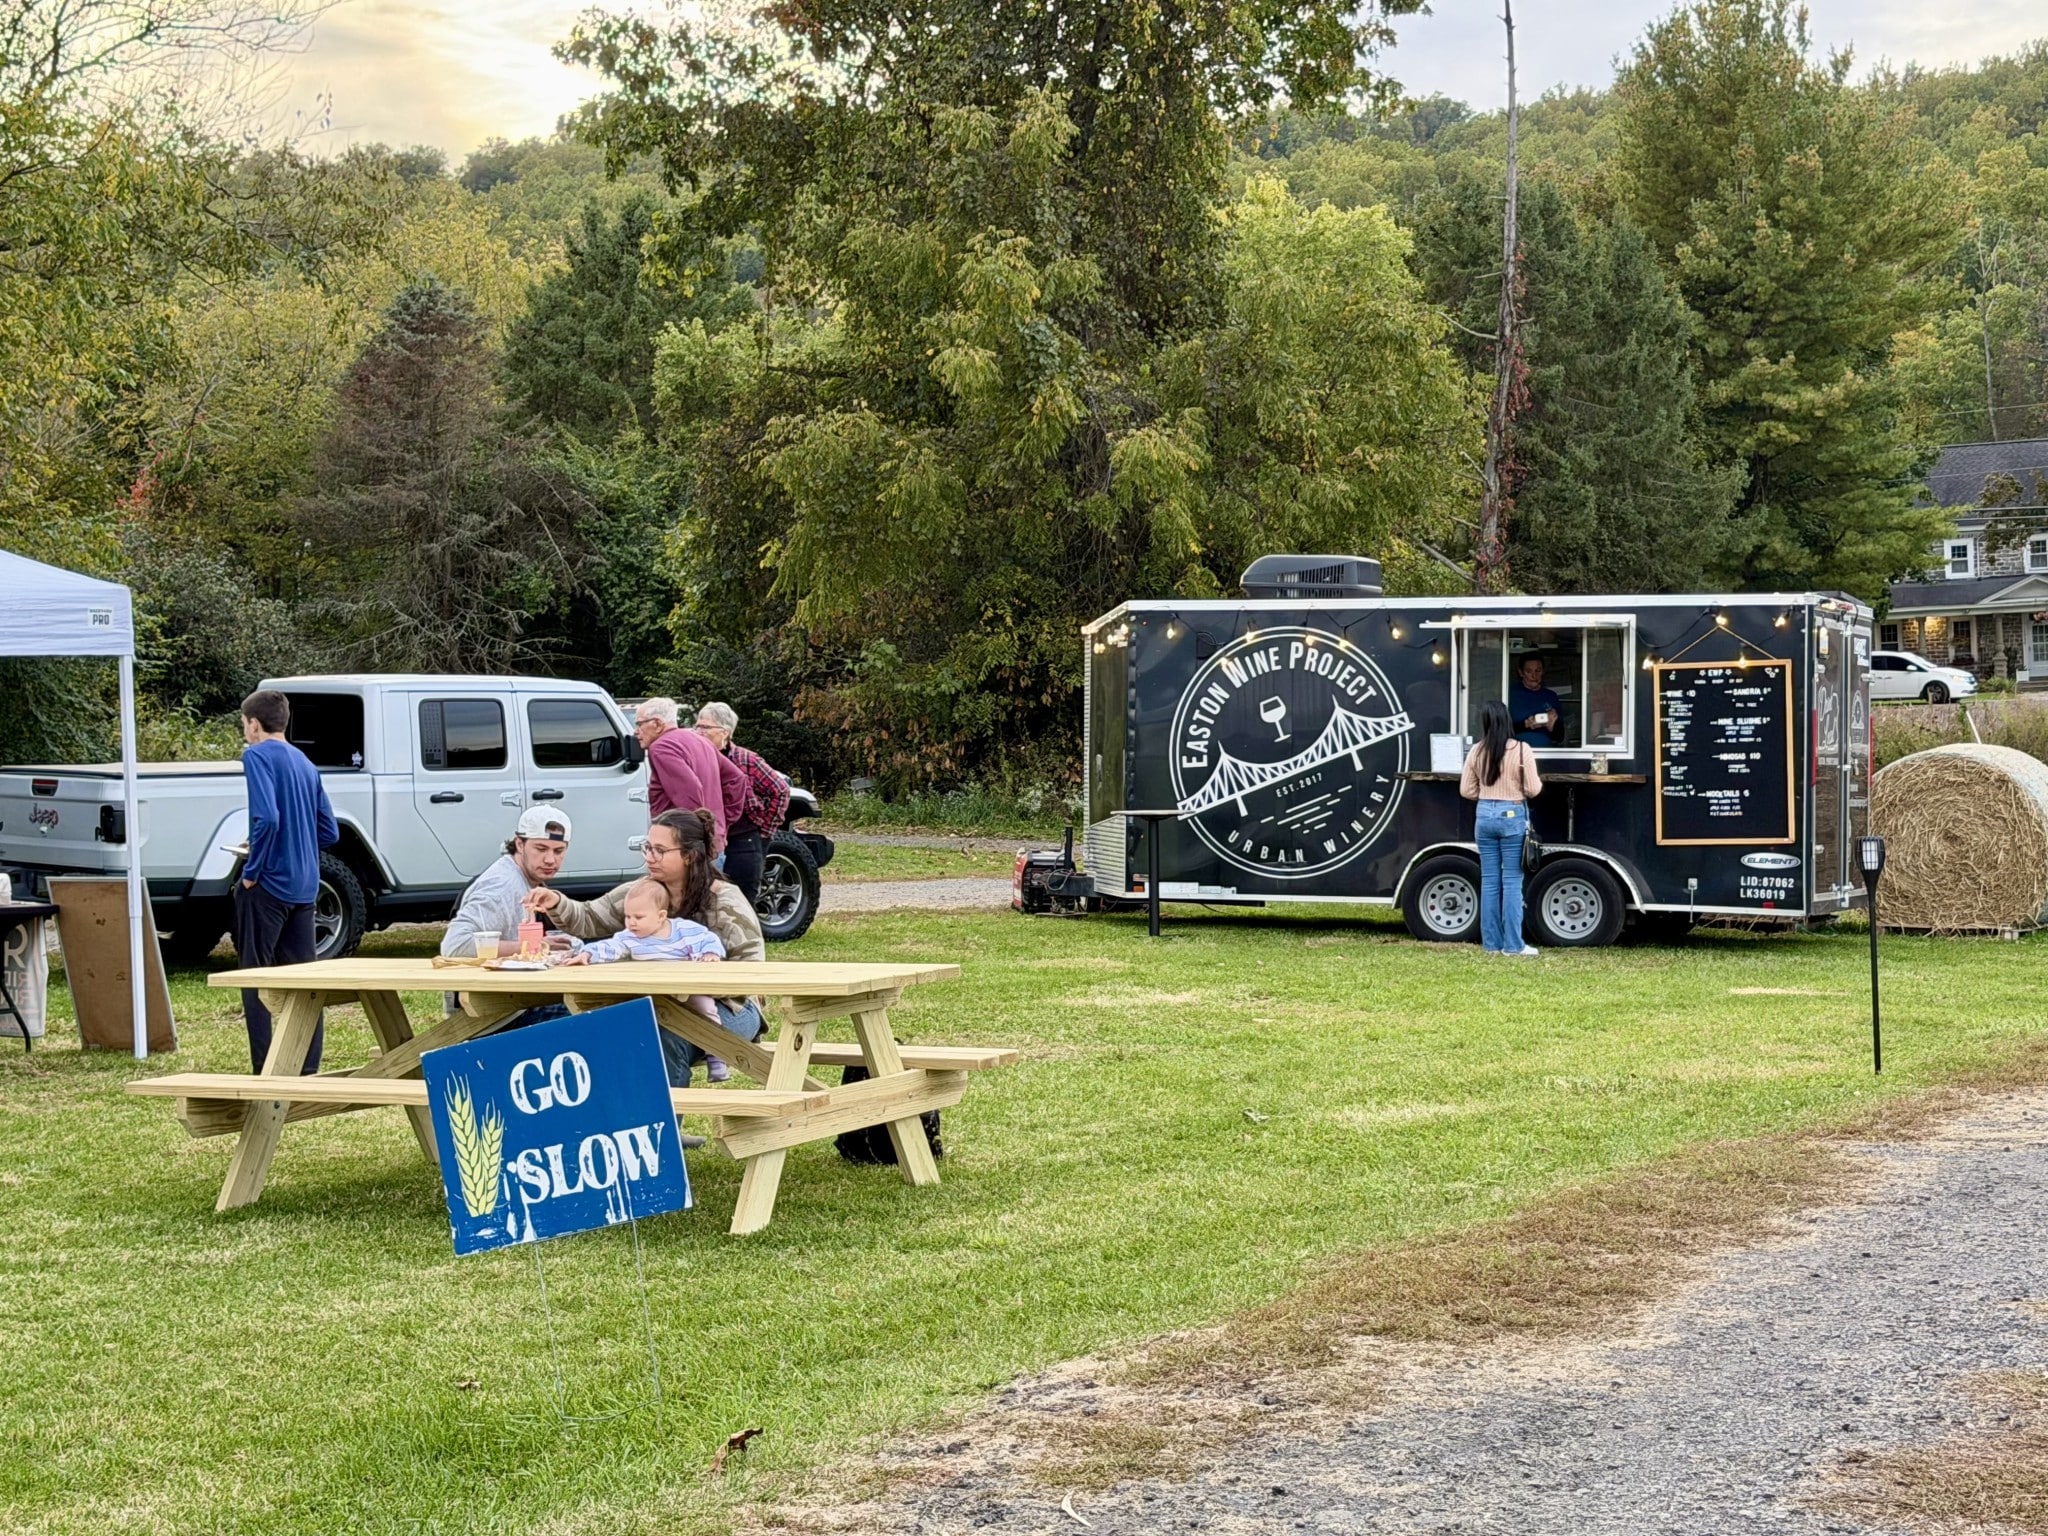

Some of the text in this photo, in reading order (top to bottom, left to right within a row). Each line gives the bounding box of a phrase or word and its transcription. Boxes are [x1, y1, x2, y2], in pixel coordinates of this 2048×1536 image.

[92, 614, 110, 625] PRO
[1182, 641, 1377, 768] EASTON WINE PROJECT
[29, 803, 59, 829] Jeep
[1227, 774, 1390, 863] URBAN WINERY
[1746, 857, 1793, 865] ELEMENT
[1740, 876, 1795, 888] LID:87062
[1740, 888, 1786, 900] LK36019
[510, 1051, 592, 1115] GO
[516, 1122, 666, 1204] SLOW
